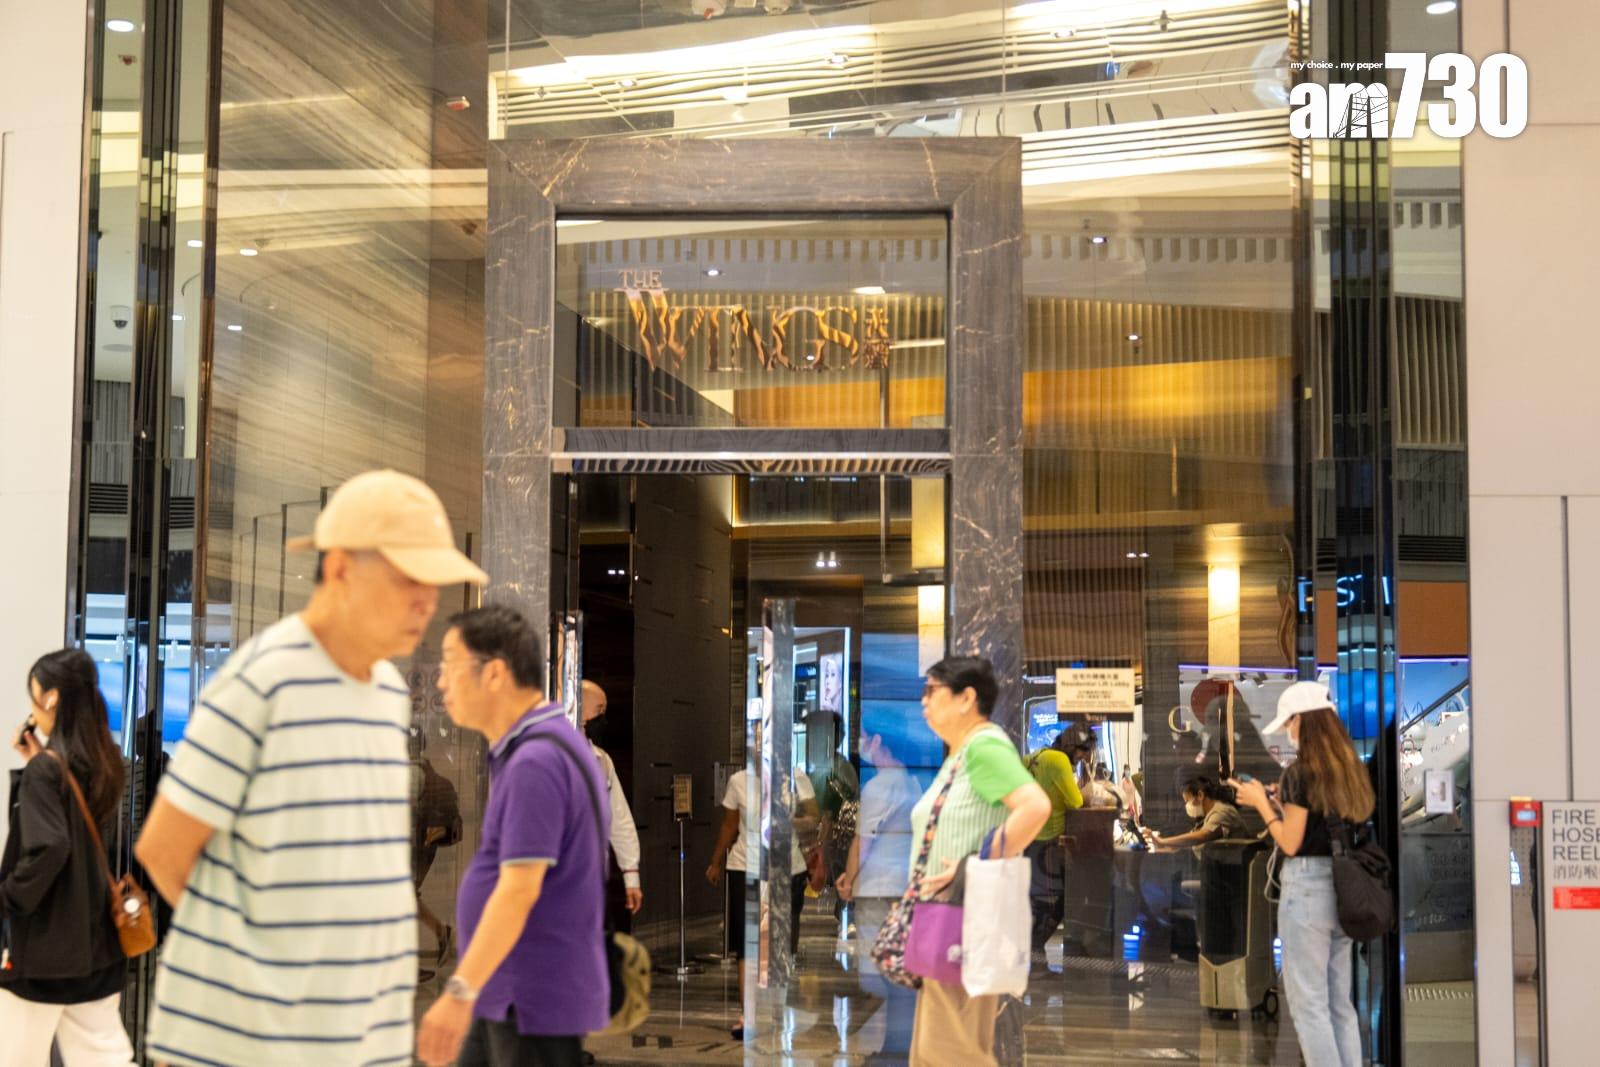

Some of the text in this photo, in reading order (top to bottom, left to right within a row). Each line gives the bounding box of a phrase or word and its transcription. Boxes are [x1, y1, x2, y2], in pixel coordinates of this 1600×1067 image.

[618, 269, 663, 290] THE
[614, 288, 858, 371] WINGS
[1552, 809, 1596, 825] FIRE
